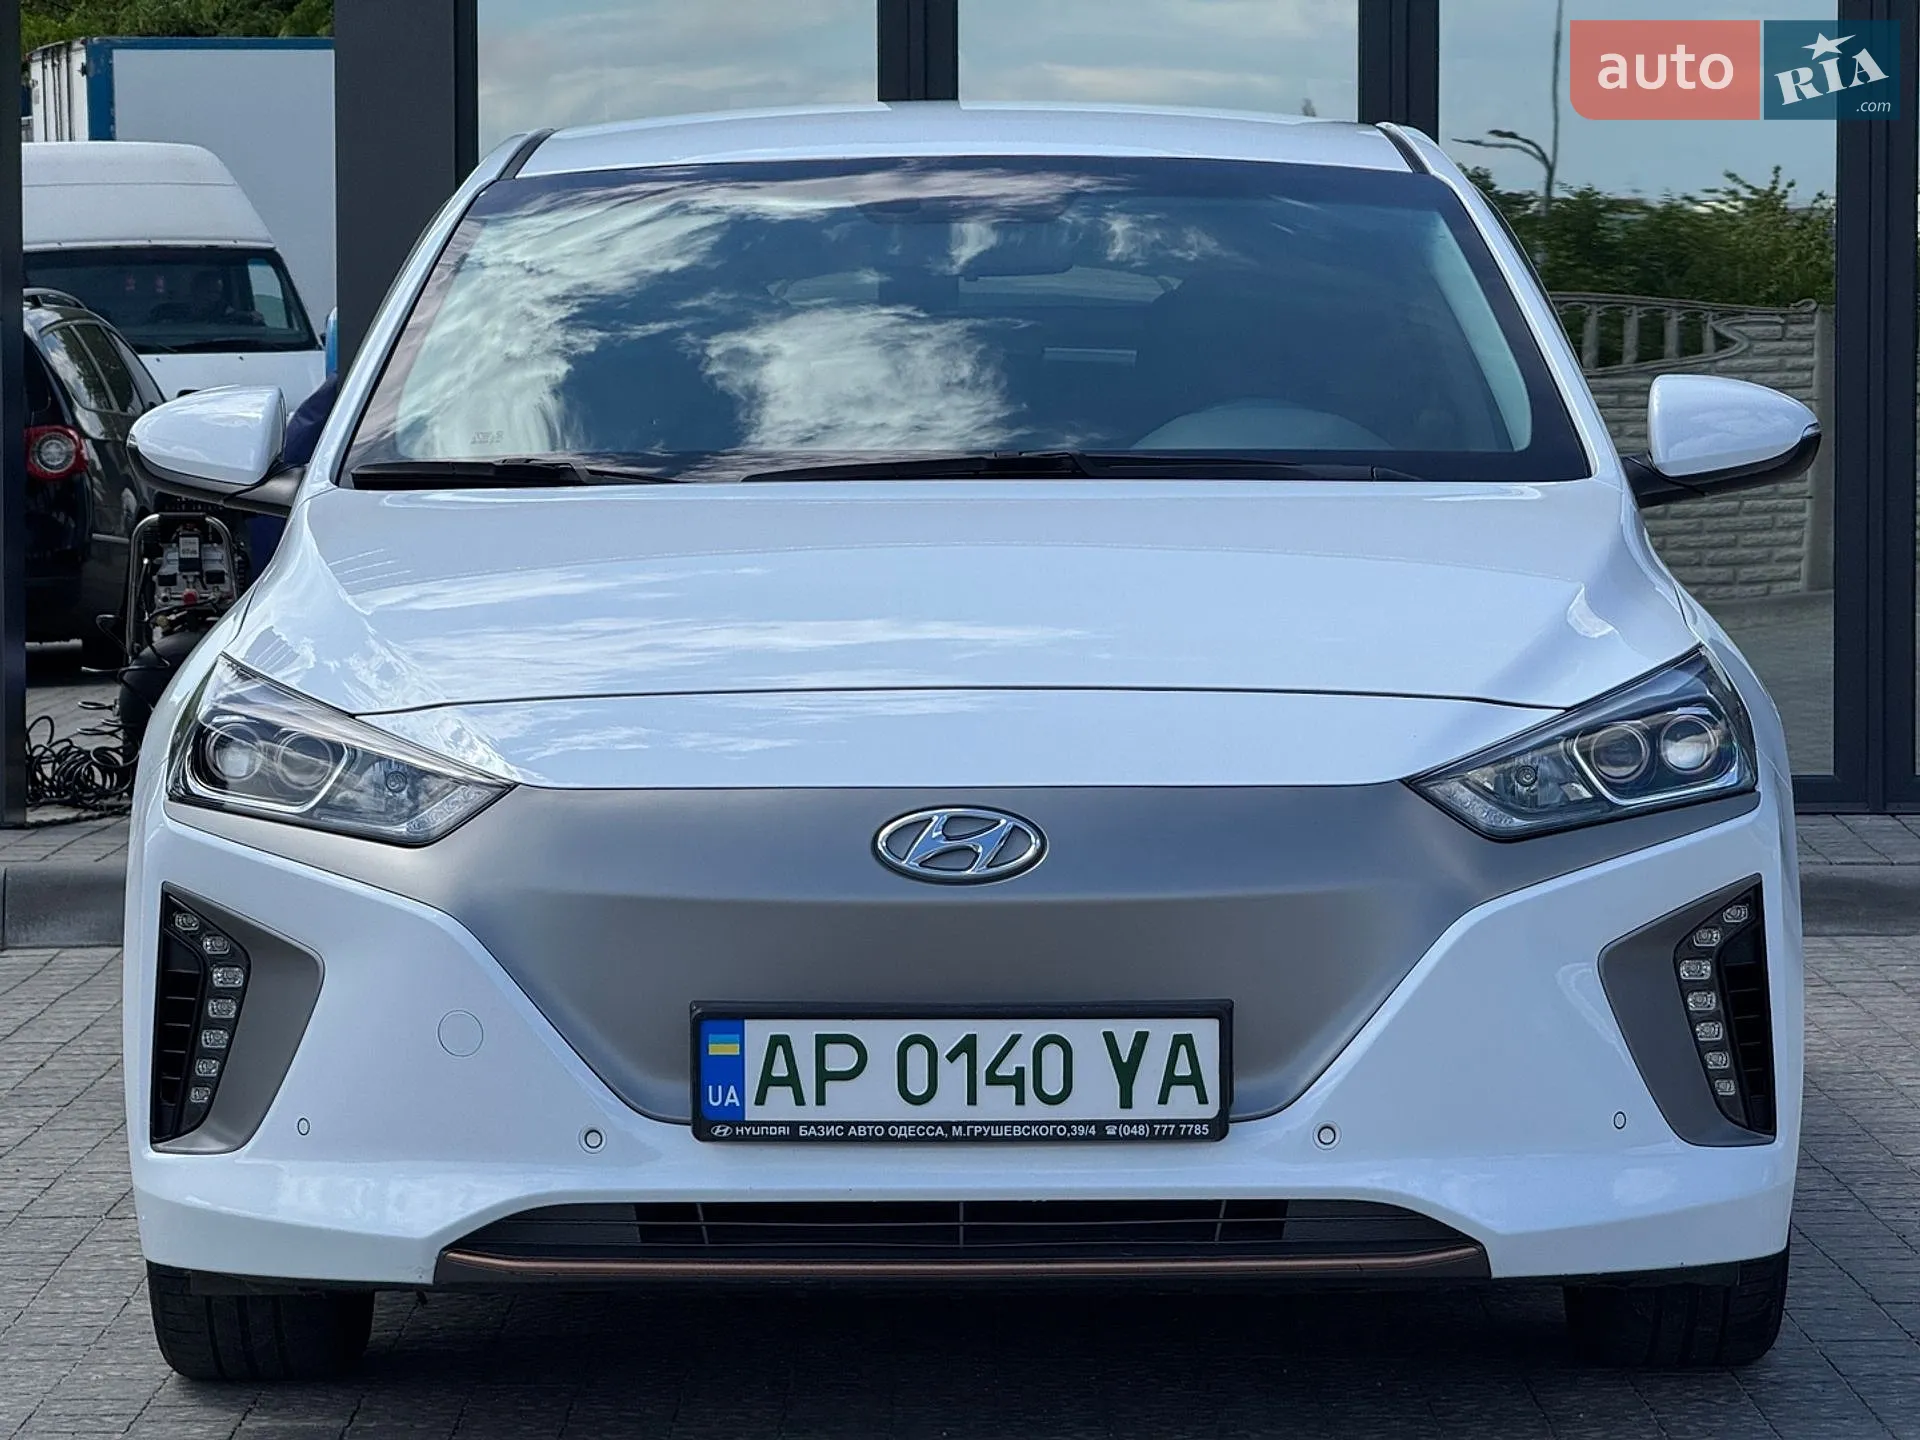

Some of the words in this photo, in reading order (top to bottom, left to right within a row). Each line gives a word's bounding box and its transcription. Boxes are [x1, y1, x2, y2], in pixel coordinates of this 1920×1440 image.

[753, 1032, 868, 1107] AP
[896, 1032, 1073, 1107] 0140
[1101, 1029, 1209, 1110] YA
[707, 1086, 740, 1107] UA
[735, 1126, 790, 1136] HYUNDAI
[799, 1125, 844, 1136] БАЗИС
[848, 1125, 884, 1136] АВТО
[888, 1125, 948, 1138] ОДЕССА,
[1118, 1124, 1150, 1137] (048)
[1153, 1124, 1175, 1136] 777
[1179, 1124, 1209, 1136] 7785
